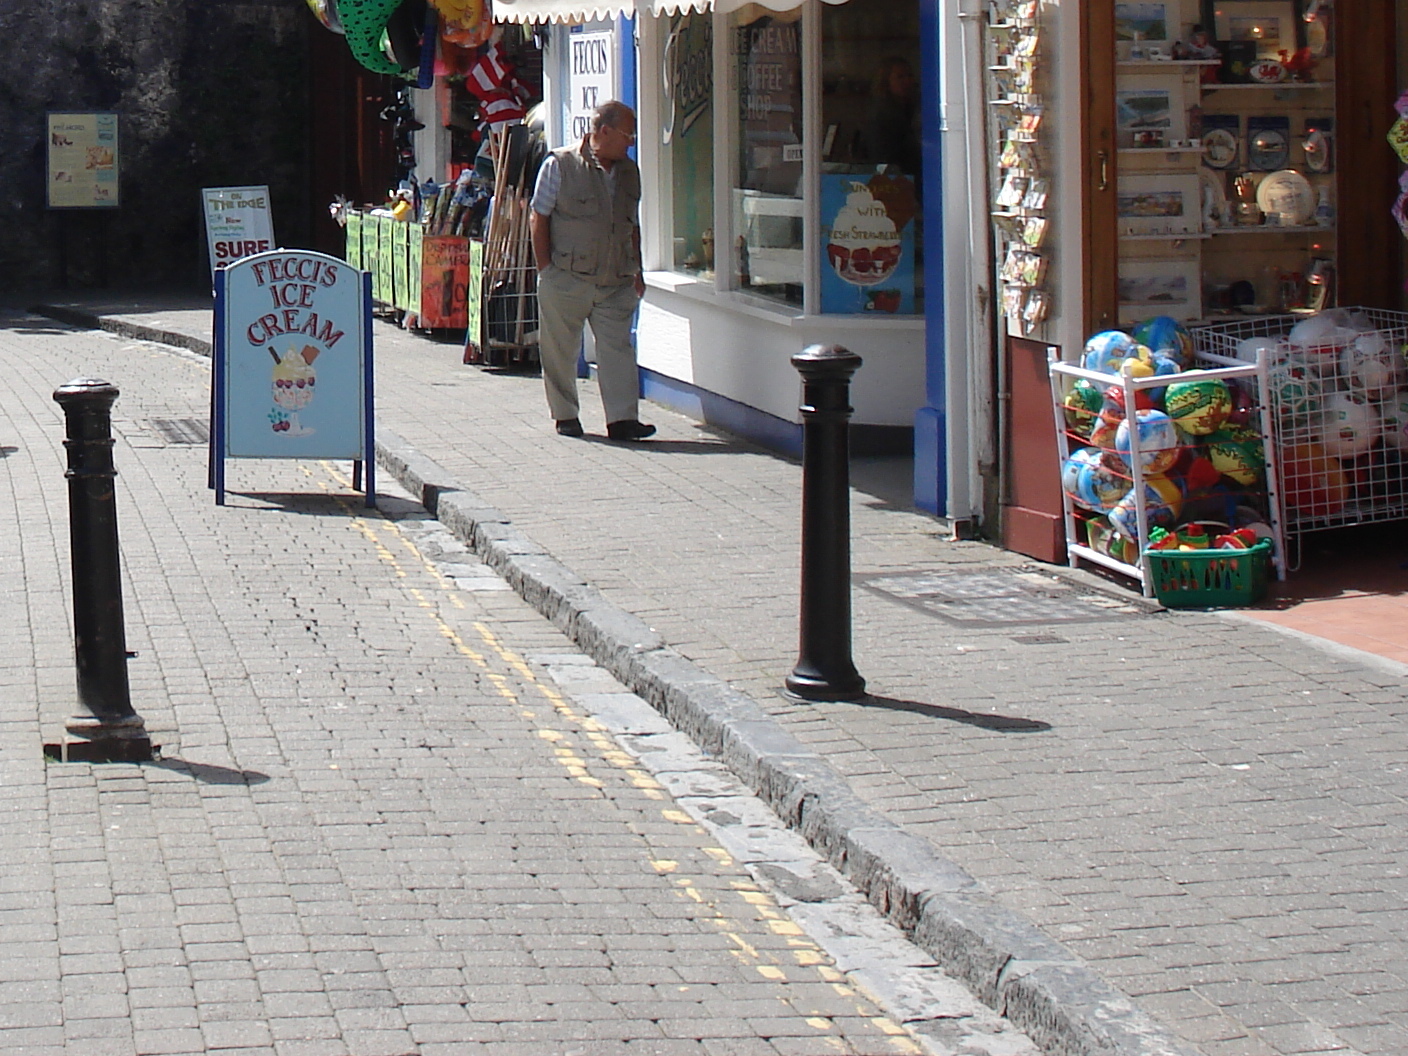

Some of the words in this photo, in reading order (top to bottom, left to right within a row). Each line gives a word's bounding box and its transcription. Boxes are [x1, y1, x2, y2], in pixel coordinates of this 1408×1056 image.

[582, 86, 599, 110] ICE
[857, 204, 887, 217] WITH
[251, 258, 338, 287] FECCI'S
[269, 283, 316, 309] ICE
[247, 309, 345, 350] CREAM
